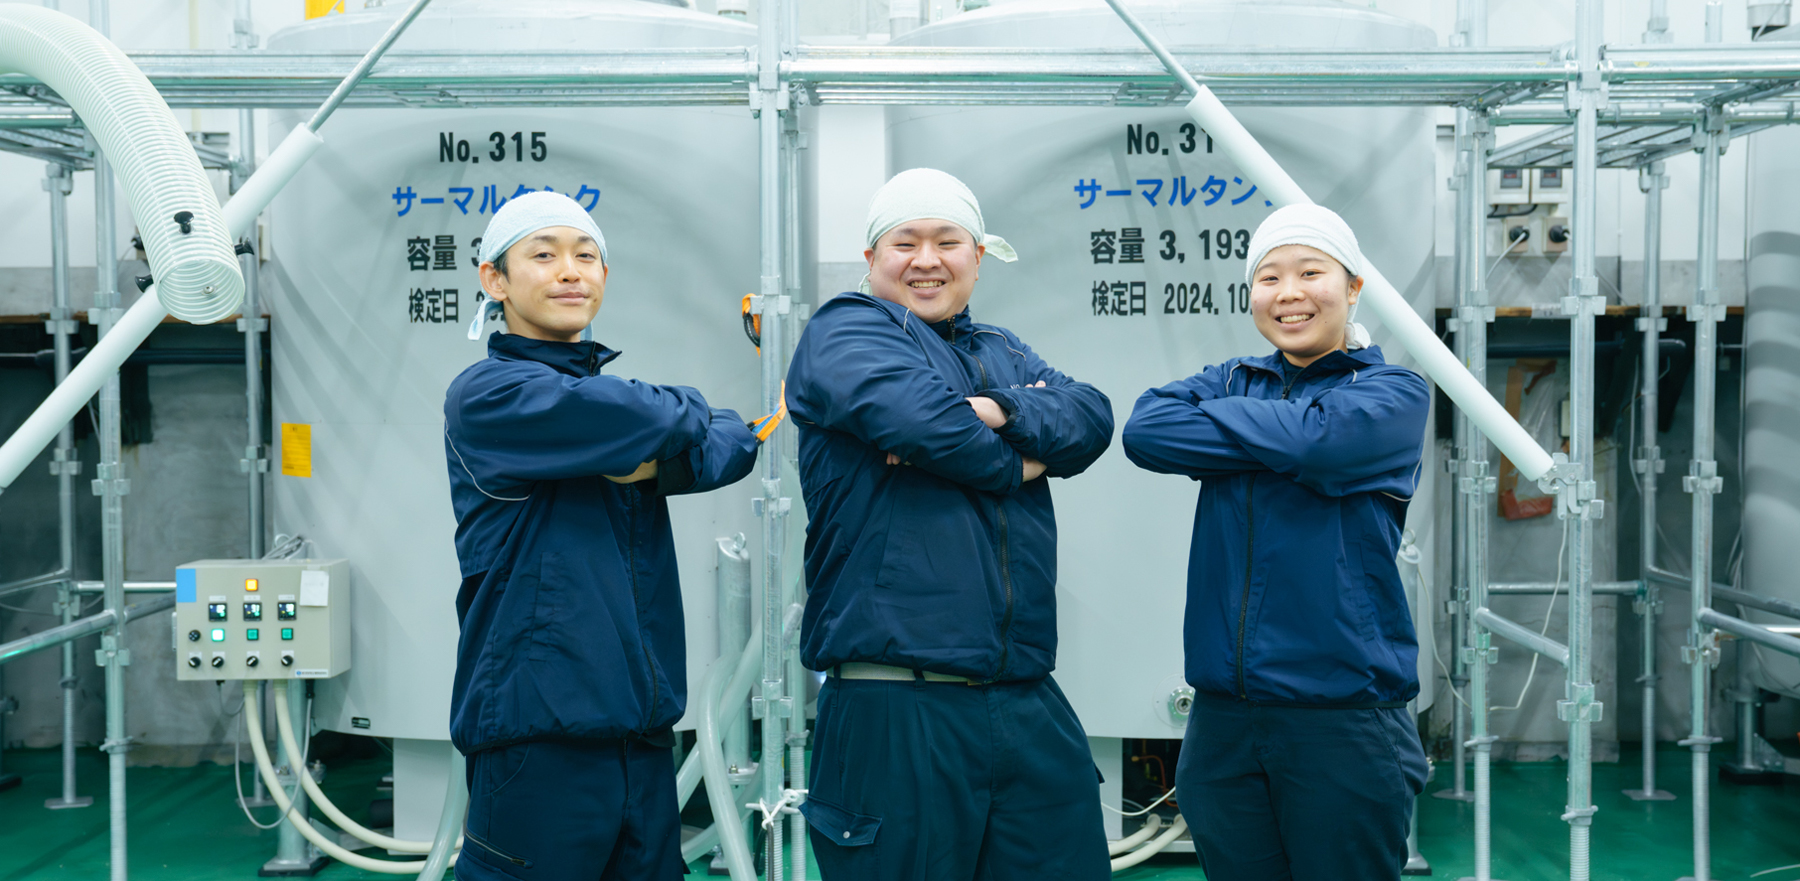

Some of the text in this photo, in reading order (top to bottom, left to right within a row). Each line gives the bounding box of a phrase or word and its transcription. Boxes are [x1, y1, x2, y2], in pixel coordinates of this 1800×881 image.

[392, 184, 601, 217] サーマルク
[1074, 174, 1273, 210] サーマルタン
[407, 234, 457, 272] 容量
[1090, 227, 1145, 265] 容量
[408, 287, 459, 324] 検定日
[1091, 280, 1146, 316] 検定日
